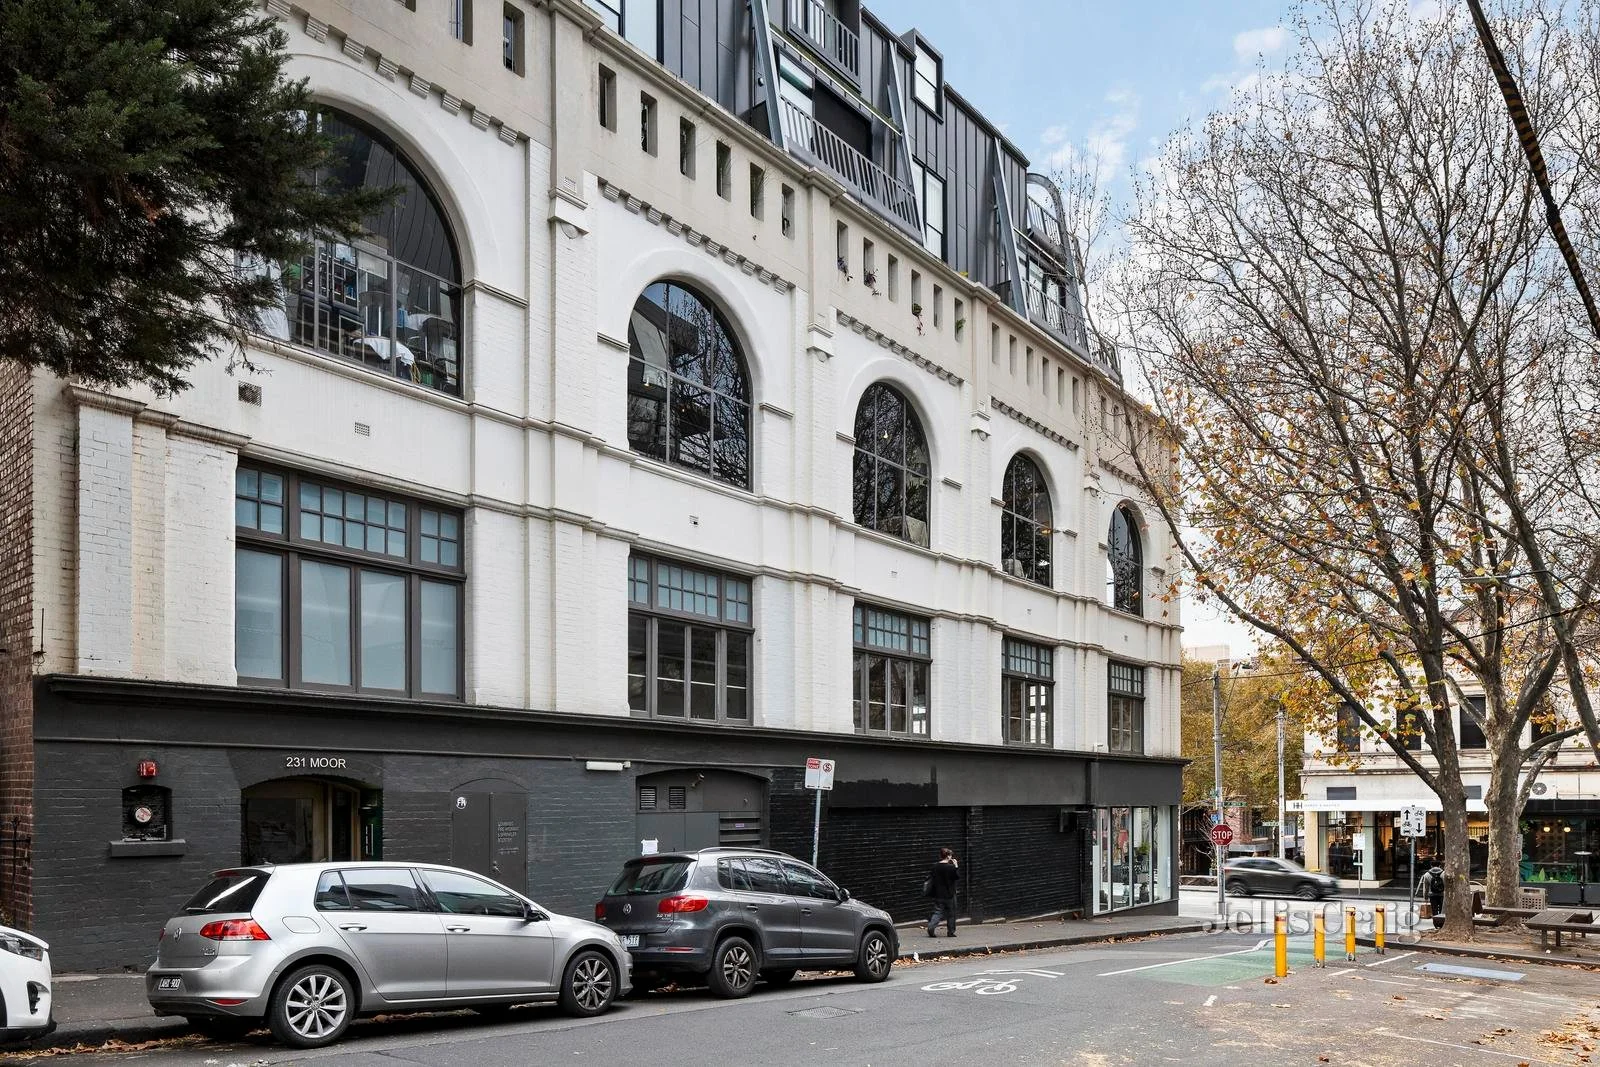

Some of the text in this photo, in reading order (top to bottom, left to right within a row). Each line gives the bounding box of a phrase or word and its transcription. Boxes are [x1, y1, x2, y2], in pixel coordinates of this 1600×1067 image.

[286, 757, 346, 769] 231 MOOR
[1212, 831, 1232, 840] STOP
